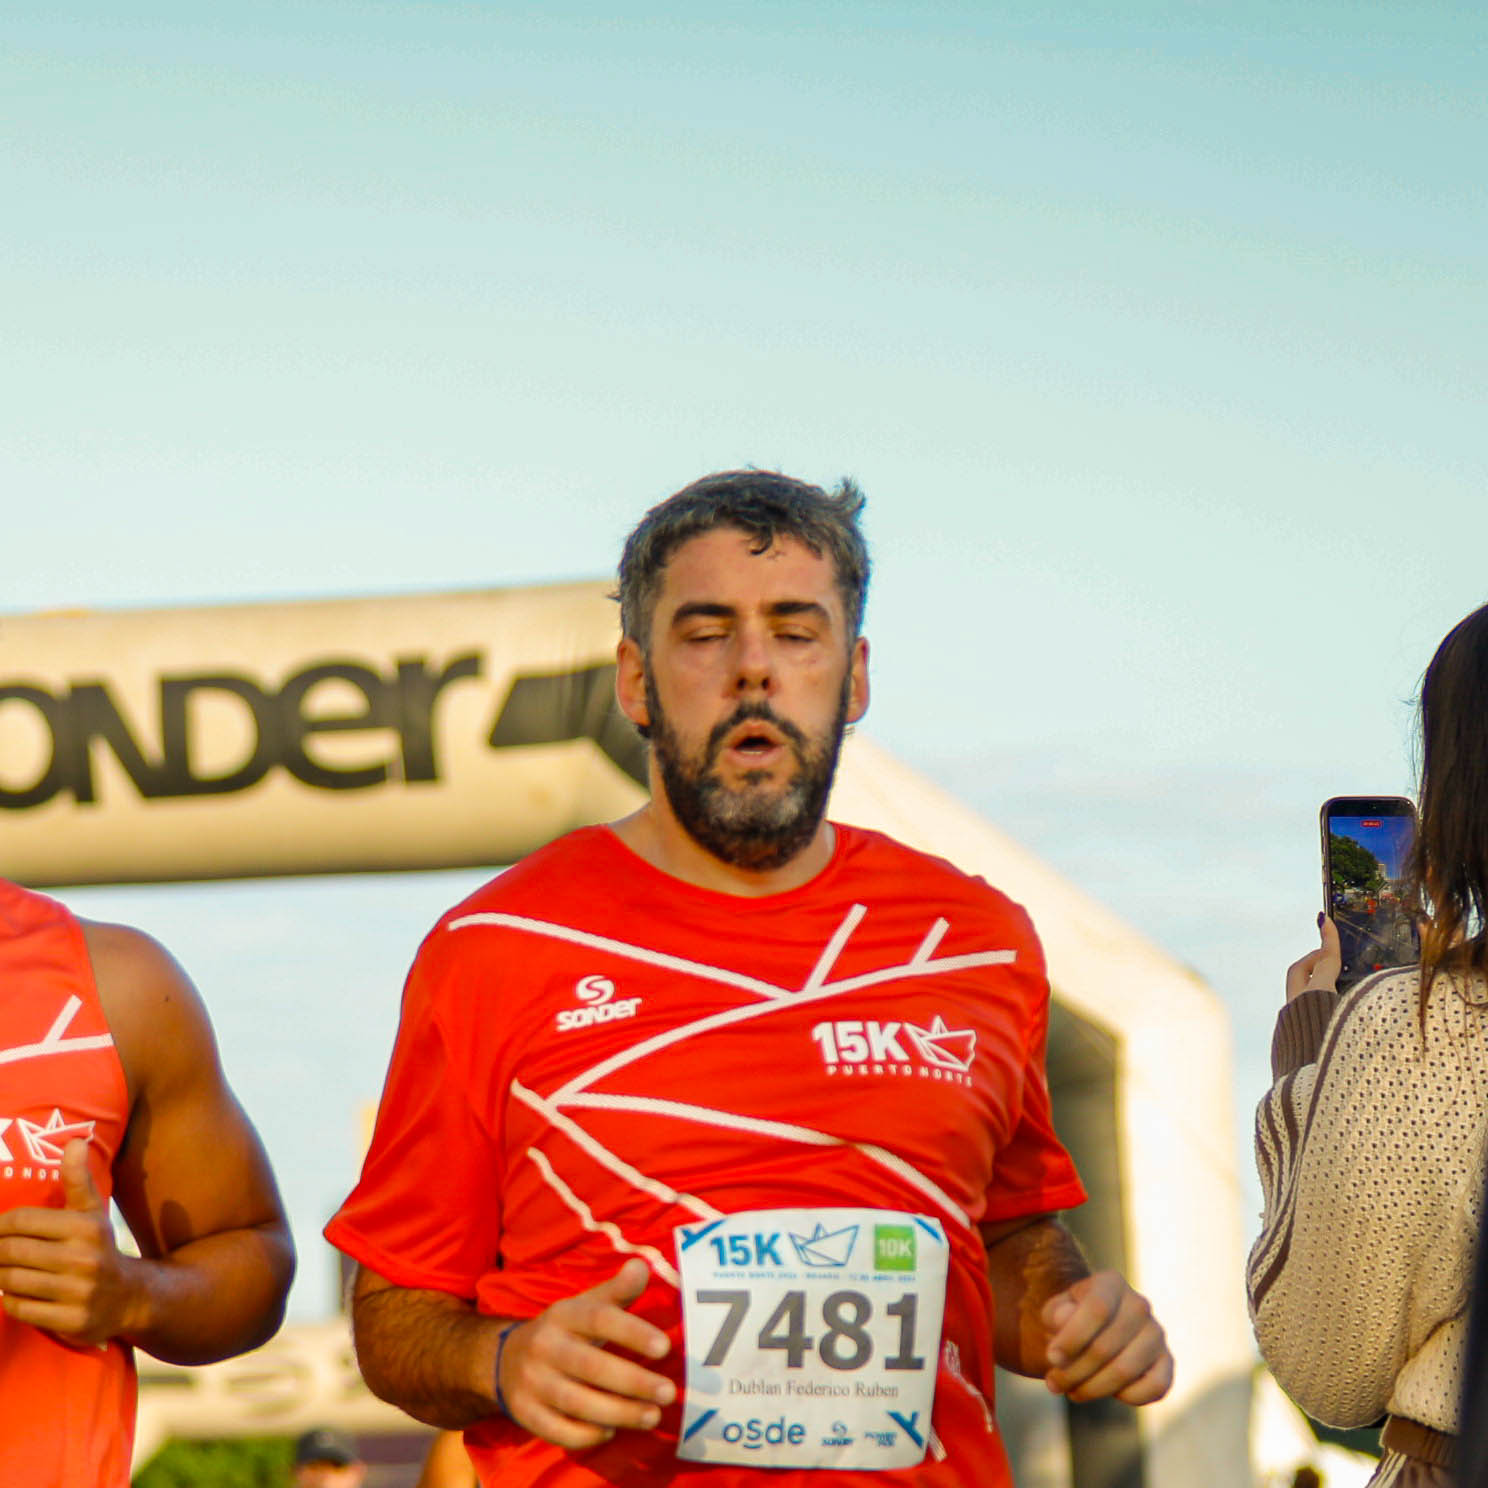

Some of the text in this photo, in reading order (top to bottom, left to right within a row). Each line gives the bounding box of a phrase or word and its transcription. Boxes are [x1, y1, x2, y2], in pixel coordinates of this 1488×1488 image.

[812, 1021, 910, 1063] 15K
[826, 1064, 913, 1076] PUERTO
[22, 1167, 61, 1181] NOR
[710, 1232, 783, 1266] 15K
[879, 1238, 913, 1257] 10K
[696, 1290, 925, 1371] 7481
[722, 1416, 806, 1448] osde
